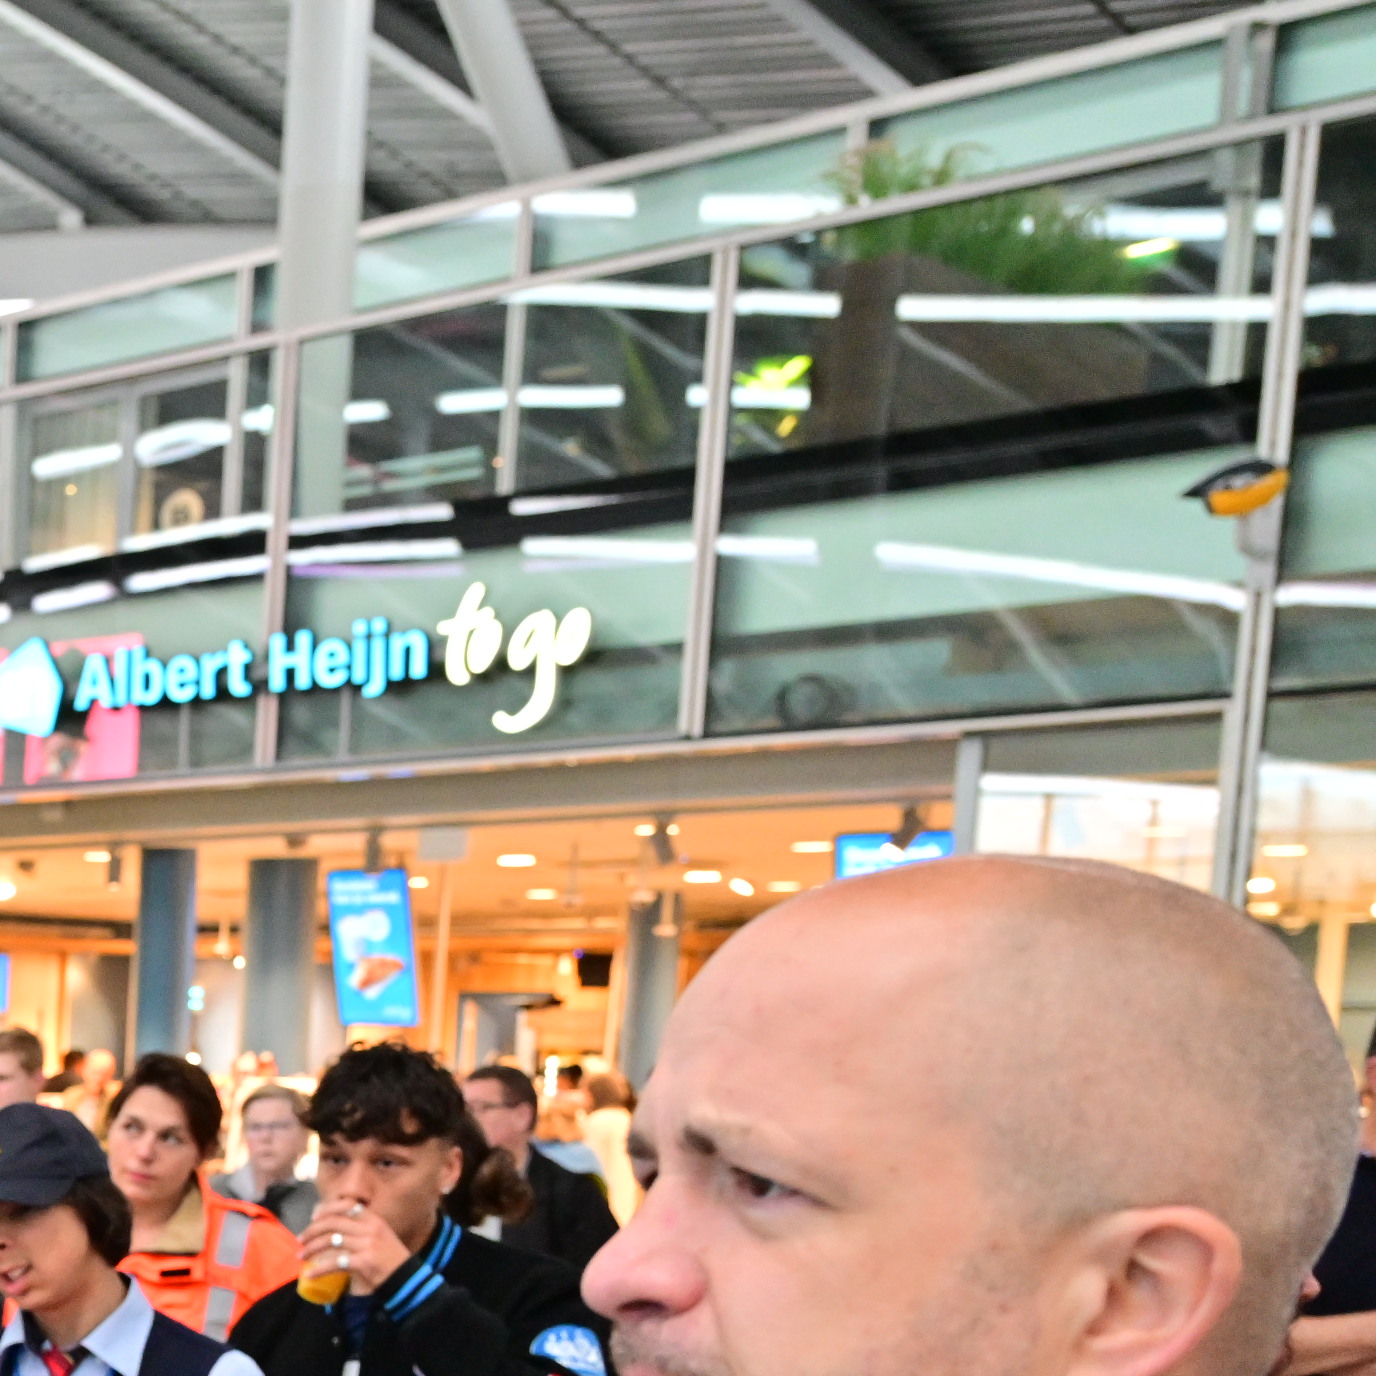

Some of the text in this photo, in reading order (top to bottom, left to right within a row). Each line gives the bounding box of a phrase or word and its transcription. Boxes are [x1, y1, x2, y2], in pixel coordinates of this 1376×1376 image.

[73, 580, 593, 734] Albert Heijn to go
